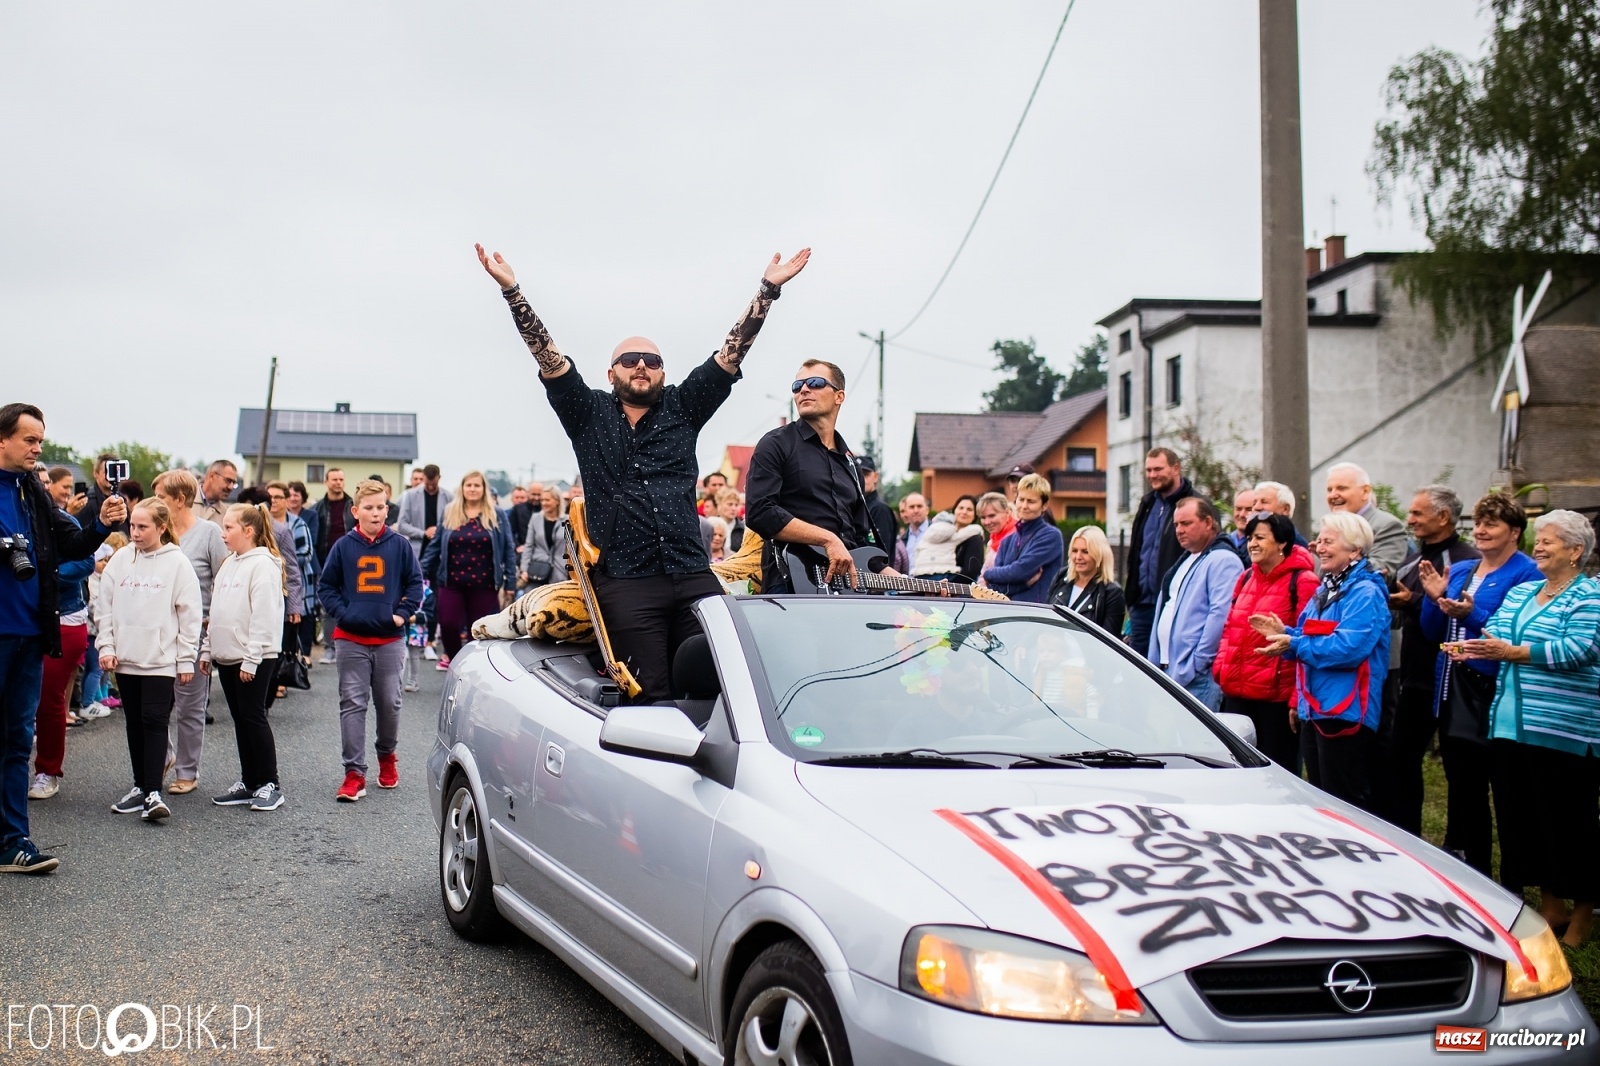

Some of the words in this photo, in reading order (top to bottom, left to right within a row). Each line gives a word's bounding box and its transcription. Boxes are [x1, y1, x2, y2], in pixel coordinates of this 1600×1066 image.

[357, 555, 385, 594] 2
[803, 727, 813, 737] 4
[961, 804, 1190, 840] TWOJA
[1132, 831, 1398, 864] GYMBA
[1037, 859, 1323, 906] BRZMI
[1117, 889, 1496, 953] ZNAJOMO
